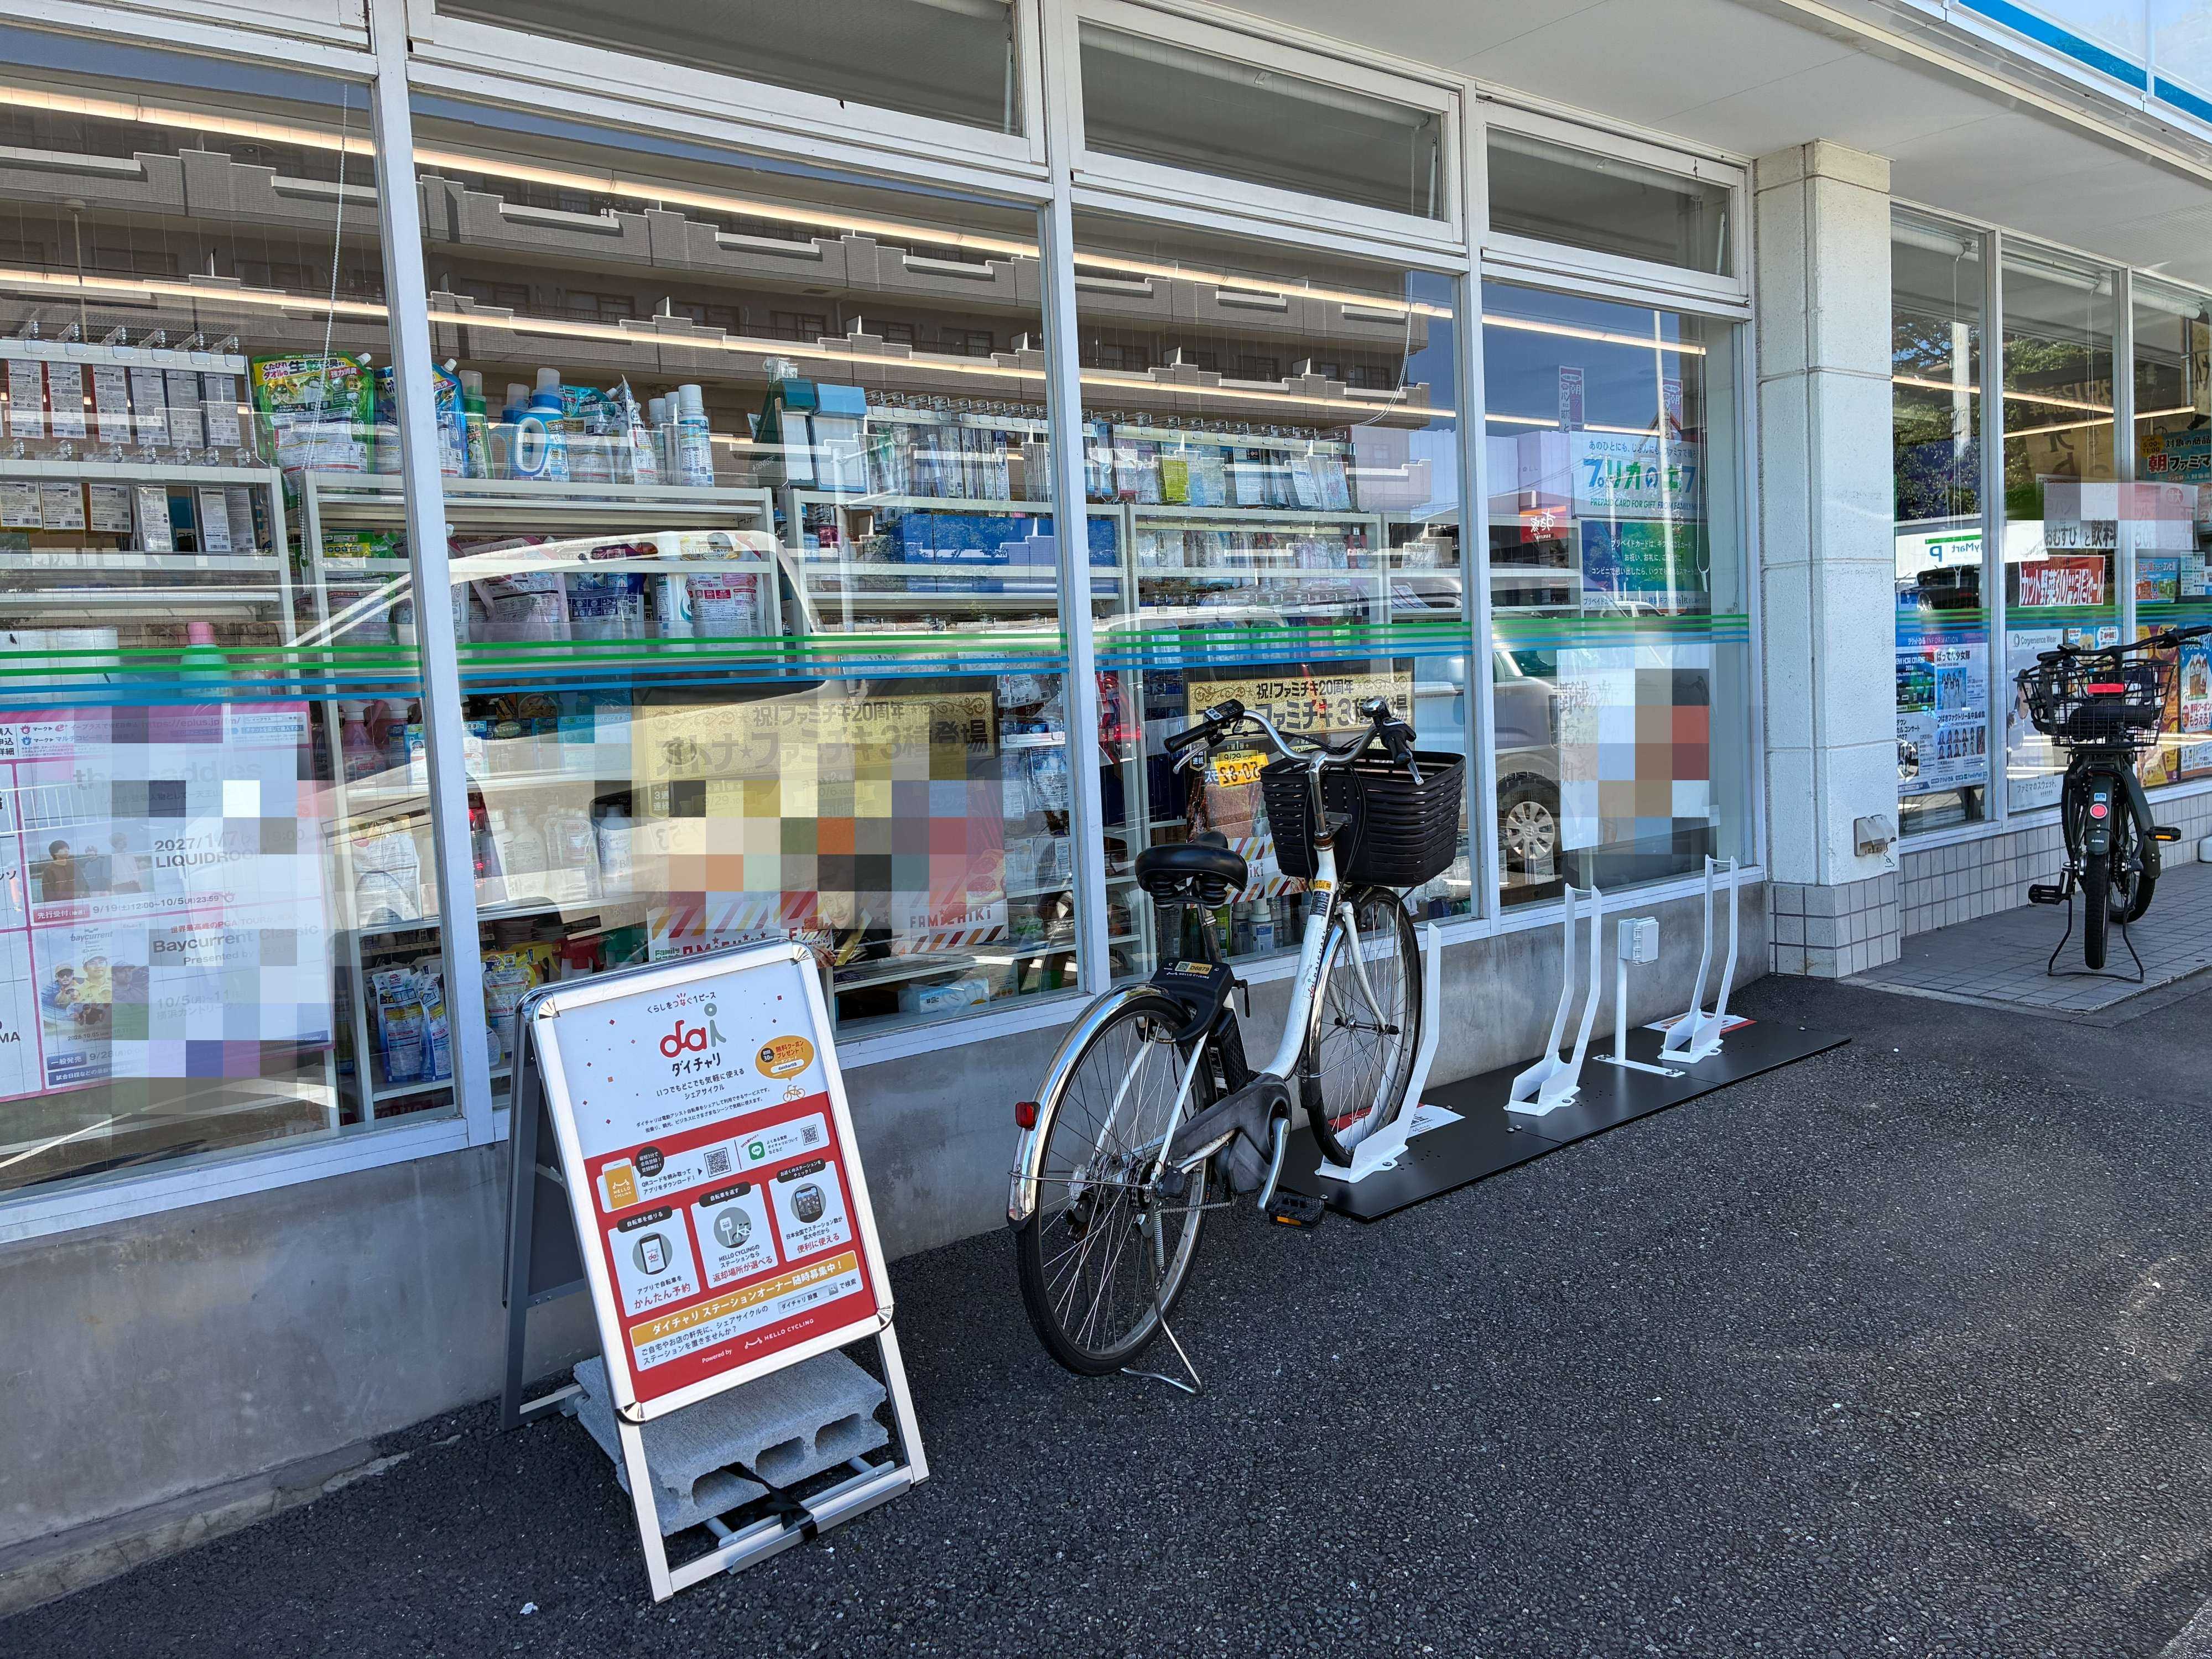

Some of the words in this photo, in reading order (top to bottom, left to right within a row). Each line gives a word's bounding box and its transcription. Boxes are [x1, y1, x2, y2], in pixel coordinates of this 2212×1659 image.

[1632, 499, 1643, 508] FOR
[672, 1052, 721, 1077] ダイチャリ
[657, 1068, 745, 1097] いつでもどこでも気軽に使える
[684, 1085, 725, 1100] シェアサイクル
[797, 1232, 840, 1254] 便利に使える
[712, 1255, 773, 1283] 返却場所が選べる
[634, 1282, 691, 1310] かんたん予約
[764, 1327, 785, 1342] HELLO
[787, 1318, 815, 1332] CYCLING
[701, 1350, 725, 1364] Powered
[725, 1348, 732, 1357] by
